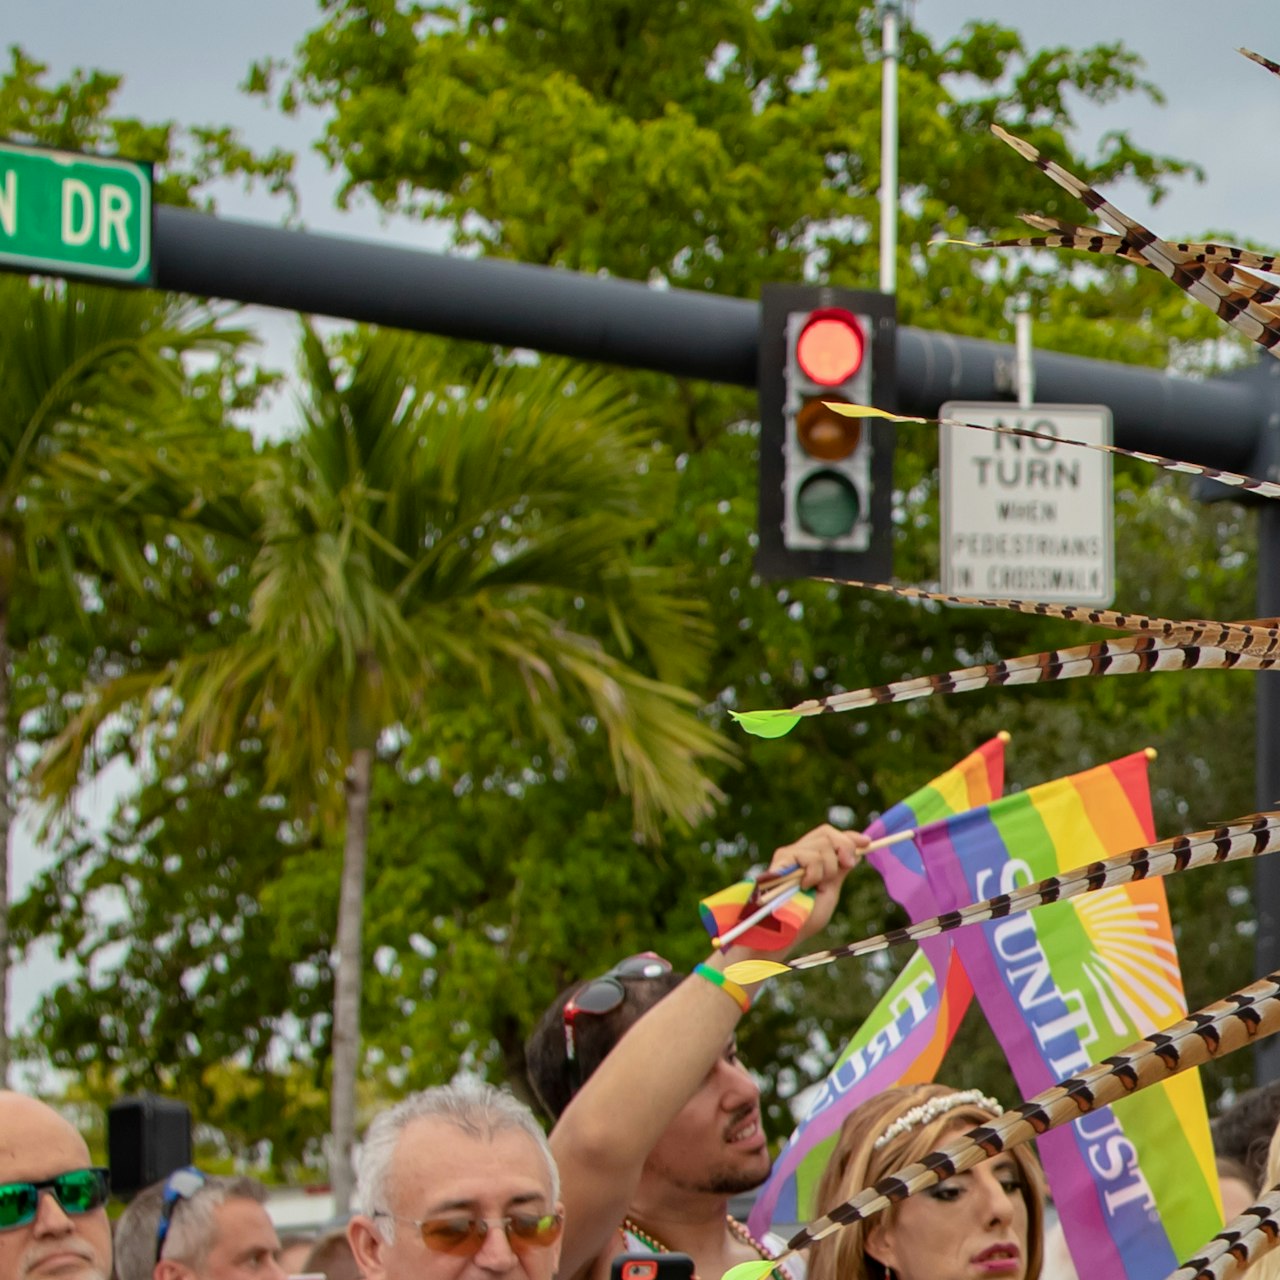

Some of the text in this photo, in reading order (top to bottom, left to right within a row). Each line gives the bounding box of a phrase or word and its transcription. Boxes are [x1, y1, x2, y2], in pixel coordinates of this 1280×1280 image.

[61, 178, 132, 254] DR
[994, 417, 1059, 454] NO
[972, 457, 1080, 489] TURN
